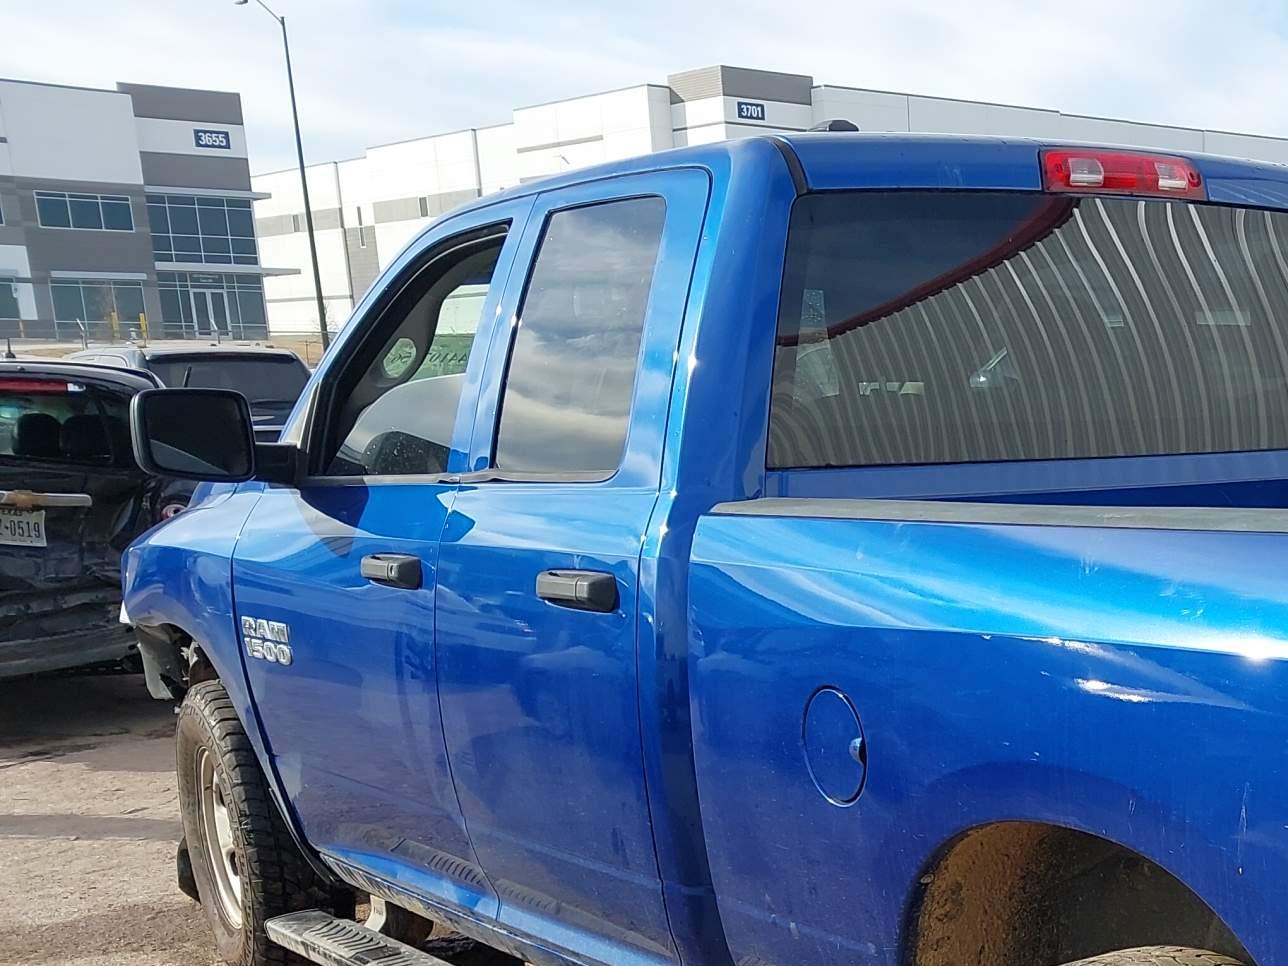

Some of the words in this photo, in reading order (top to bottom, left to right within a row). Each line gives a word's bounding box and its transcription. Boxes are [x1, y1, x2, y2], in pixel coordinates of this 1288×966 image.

[741, 104, 762, 118] 3701
[197, 132, 227, 146] 3655
[241, 615, 289, 643] RAM
[244, 637, 292, 665] 1500
